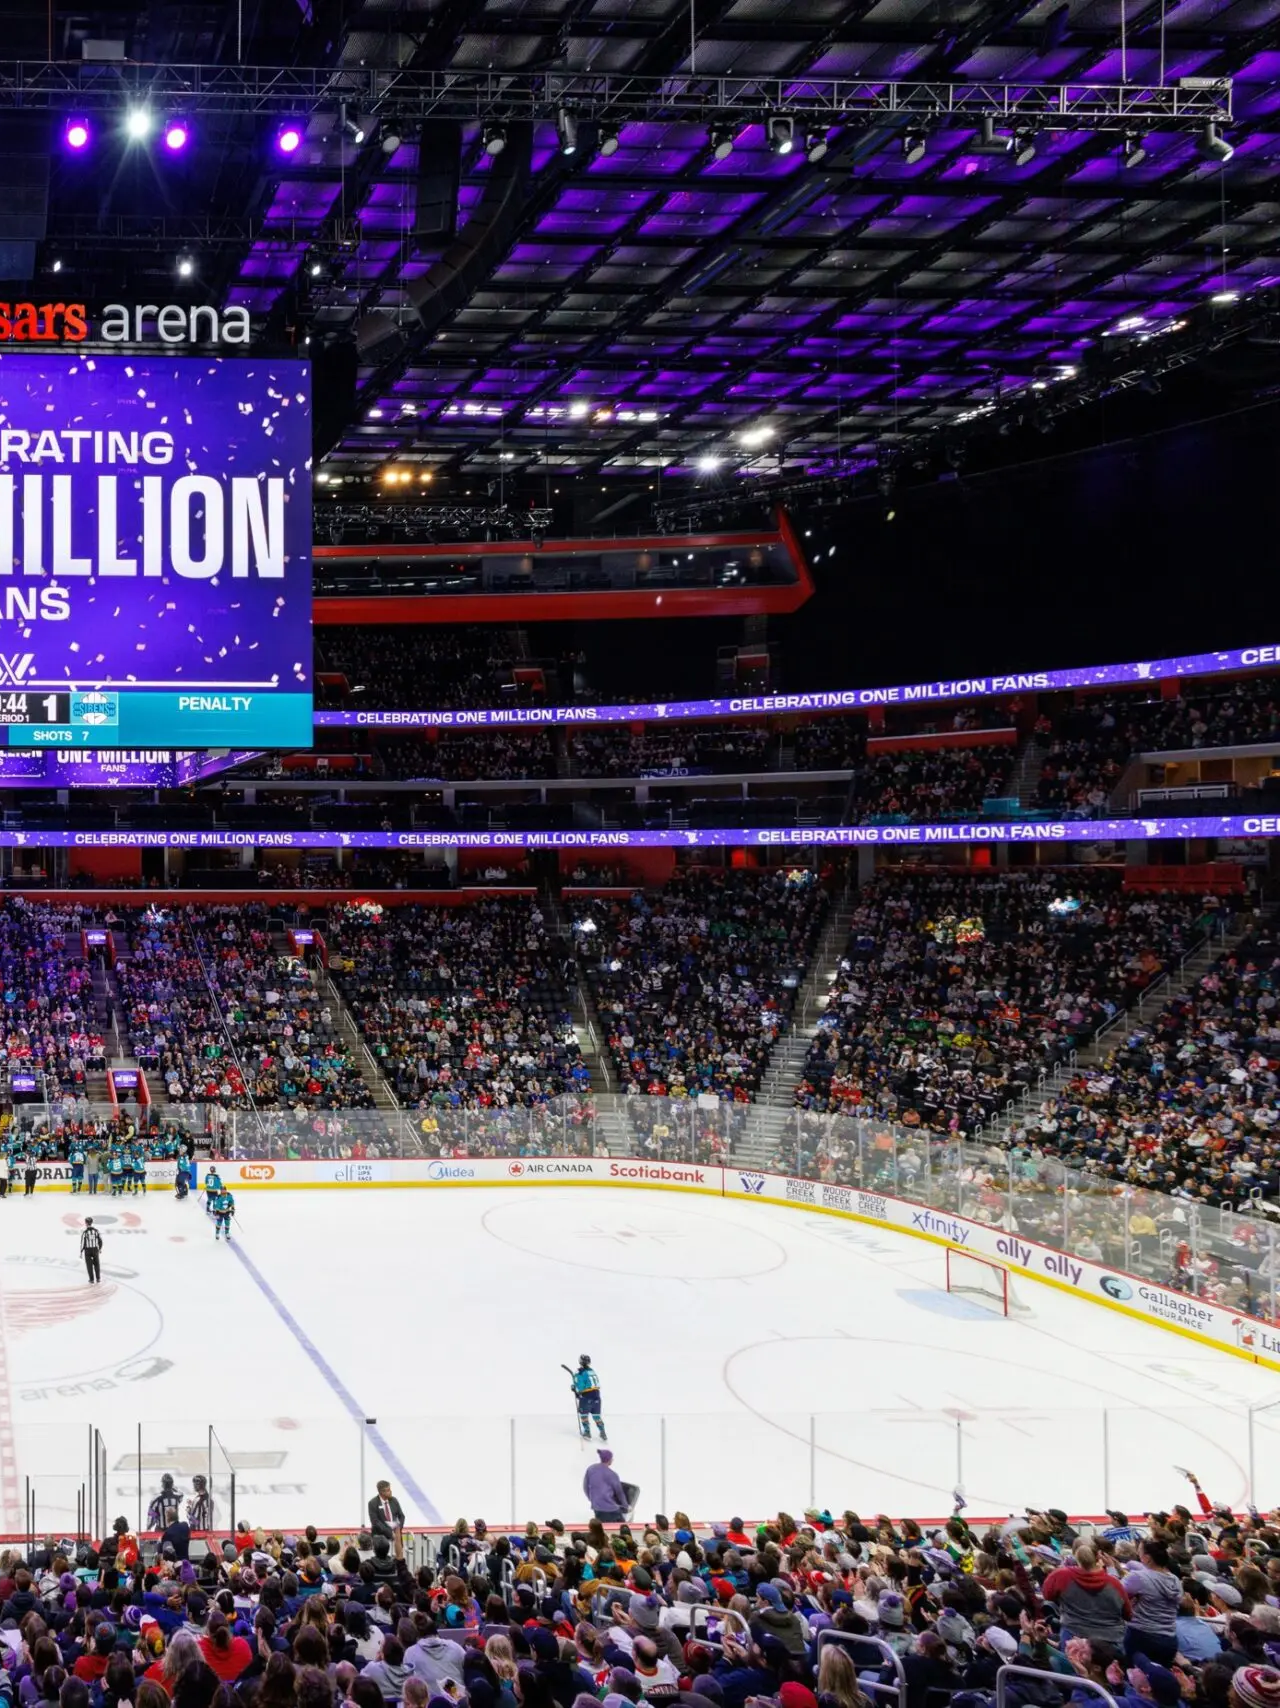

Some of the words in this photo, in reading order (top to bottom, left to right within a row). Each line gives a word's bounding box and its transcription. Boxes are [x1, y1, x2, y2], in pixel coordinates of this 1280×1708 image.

[101, 303, 251, 344] arena
[729, 691, 855, 712] CELEBRATING
[860, 687, 900, 704] ONE
[904, 679, 986, 700] MILLION
[992, 673, 1049, 692] FANS
[42, 694, 57, 722] 1
[79, 703, 110, 717] SIRENS
[178, 696, 253, 712] PENALTY
[356, 711, 453, 725] CELEBRATING
[456, 711, 487, 724] ONE
[489, 709, 553, 723] MILLION
[555, 707, 598, 721] FANS
[33, 730, 73, 741] SHOTS
[81, 730, 90, 741] 7
[56, 750, 92, 765] ONE
[96, 750, 171, 765] MILLION
[100, 764, 127, 773] FANS
[74, 832, 169, 845] CELEBRATING
[170, 832, 198, 845] ONE
[201, 832, 256, 846] MILLION
[258, 832, 292, 846] FANS
[398, 833, 492, 845] CELEBRATING
[494, 833, 524, 845] ONE
[526, 833, 587, 845] MILLION
[590, 832, 630, 845] FANS
[758, 829, 878, 843] CELEBRATING
[882, 827, 921, 842] ONE
[925, 826, 1005, 840] MILLION
[1010, 824, 1066, 840] FANS
[245, 1165, 271, 1180] hap
[435, 1166, 475, 1178] Midea
[526, 1165, 546, 1173] AIR
[547, 1164, 594, 1173] CANADA
[609, 1162, 705, 1184] Scotiabank
[785, 1186, 815, 1197] CREEK
[786, 1179, 816, 1190] WOODY
[822, 1185, 852, 1197] WOODY
[822, 1193, 851, 1205] CREEK
[858, 1192, 888, 1206] WOODY
[858, 1201, 887, 1213] CREEK
[912, 1210, 970, 1245] xfinity
[996, 1237, 1032, 1266] ally
[1044, 1254, 1083, 1285] ally
[1138, 1286, 1214, 1323] Gallagher
[1148, 1304, 1204, 1331] INSURANCE
[1260, 1333, 1280, 1354] Lit
[20, 1378, 119, 1403] arena
